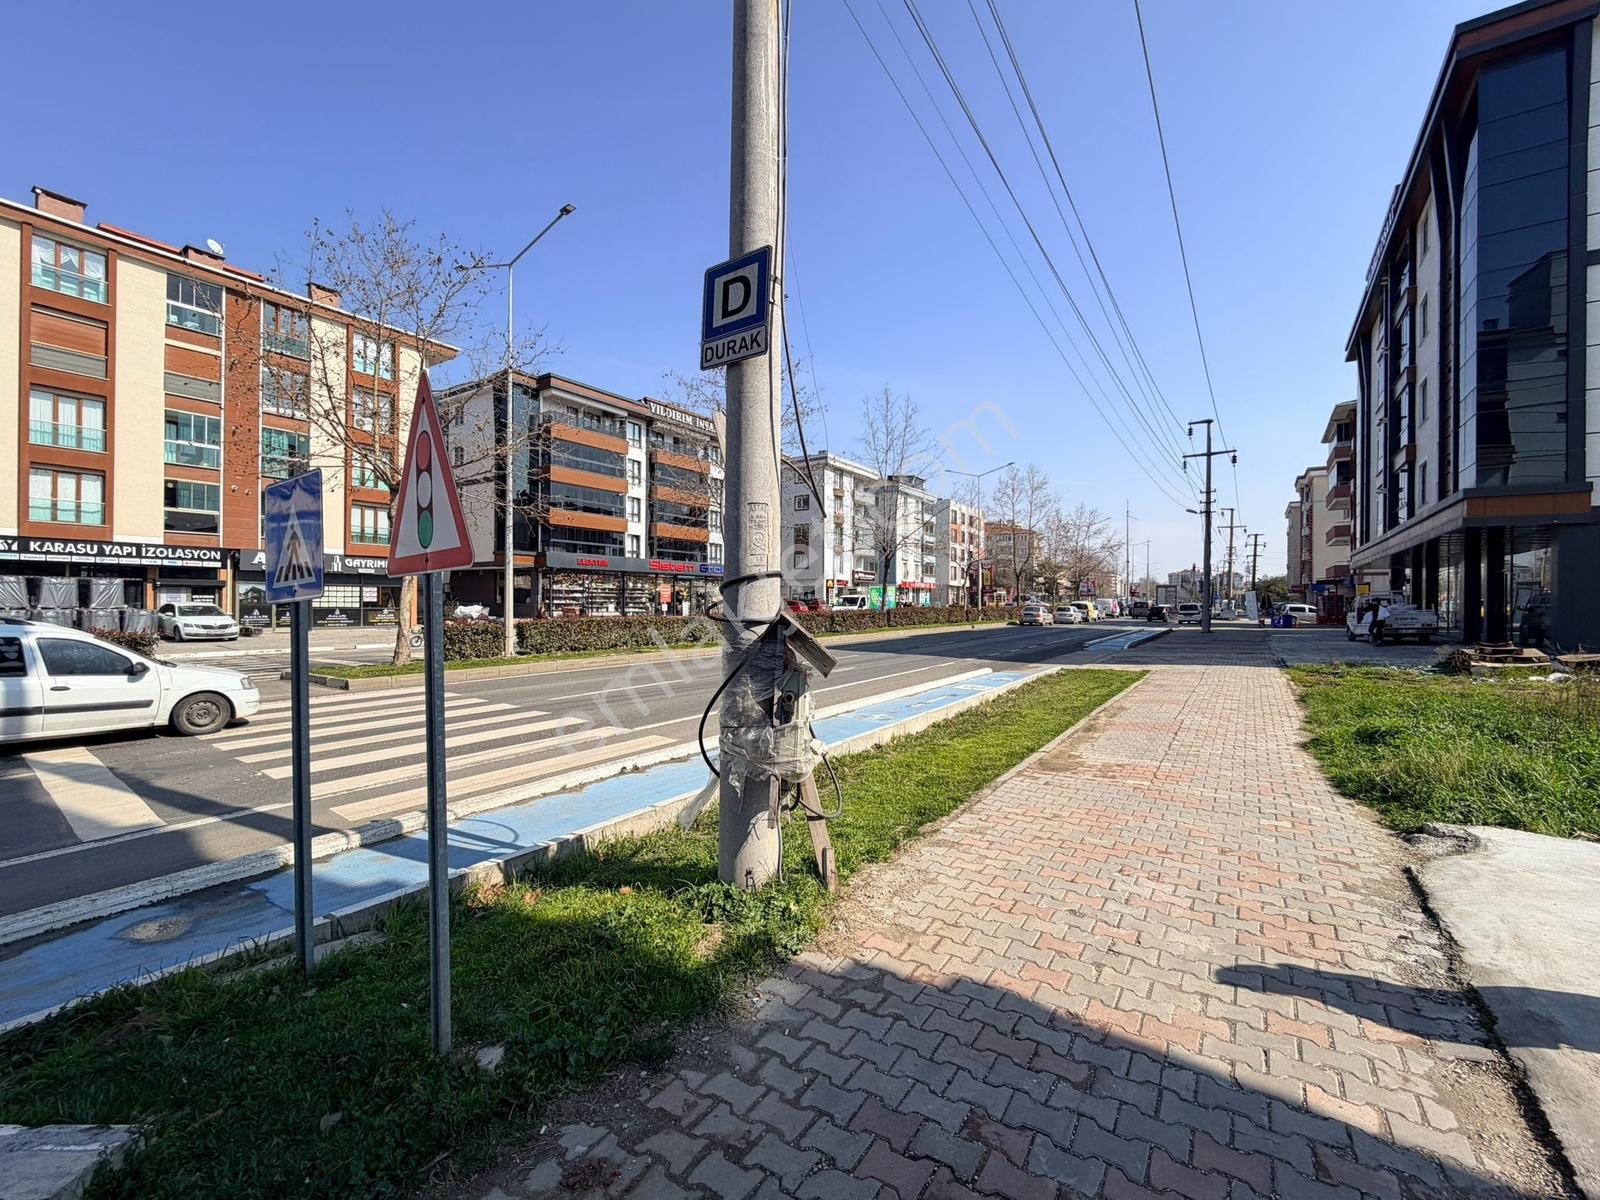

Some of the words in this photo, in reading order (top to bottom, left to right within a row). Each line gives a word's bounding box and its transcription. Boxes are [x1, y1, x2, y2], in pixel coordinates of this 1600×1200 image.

[721, 275, 752, 319] D
[704, 330, 762, 364] DURAK
[29, 540, 98, 555] KARASU
[102, 544, 137, 557] YAPI
[141, 544, 221, 560] İZOLASYON
[648, 559, 696, 573] Sistem
